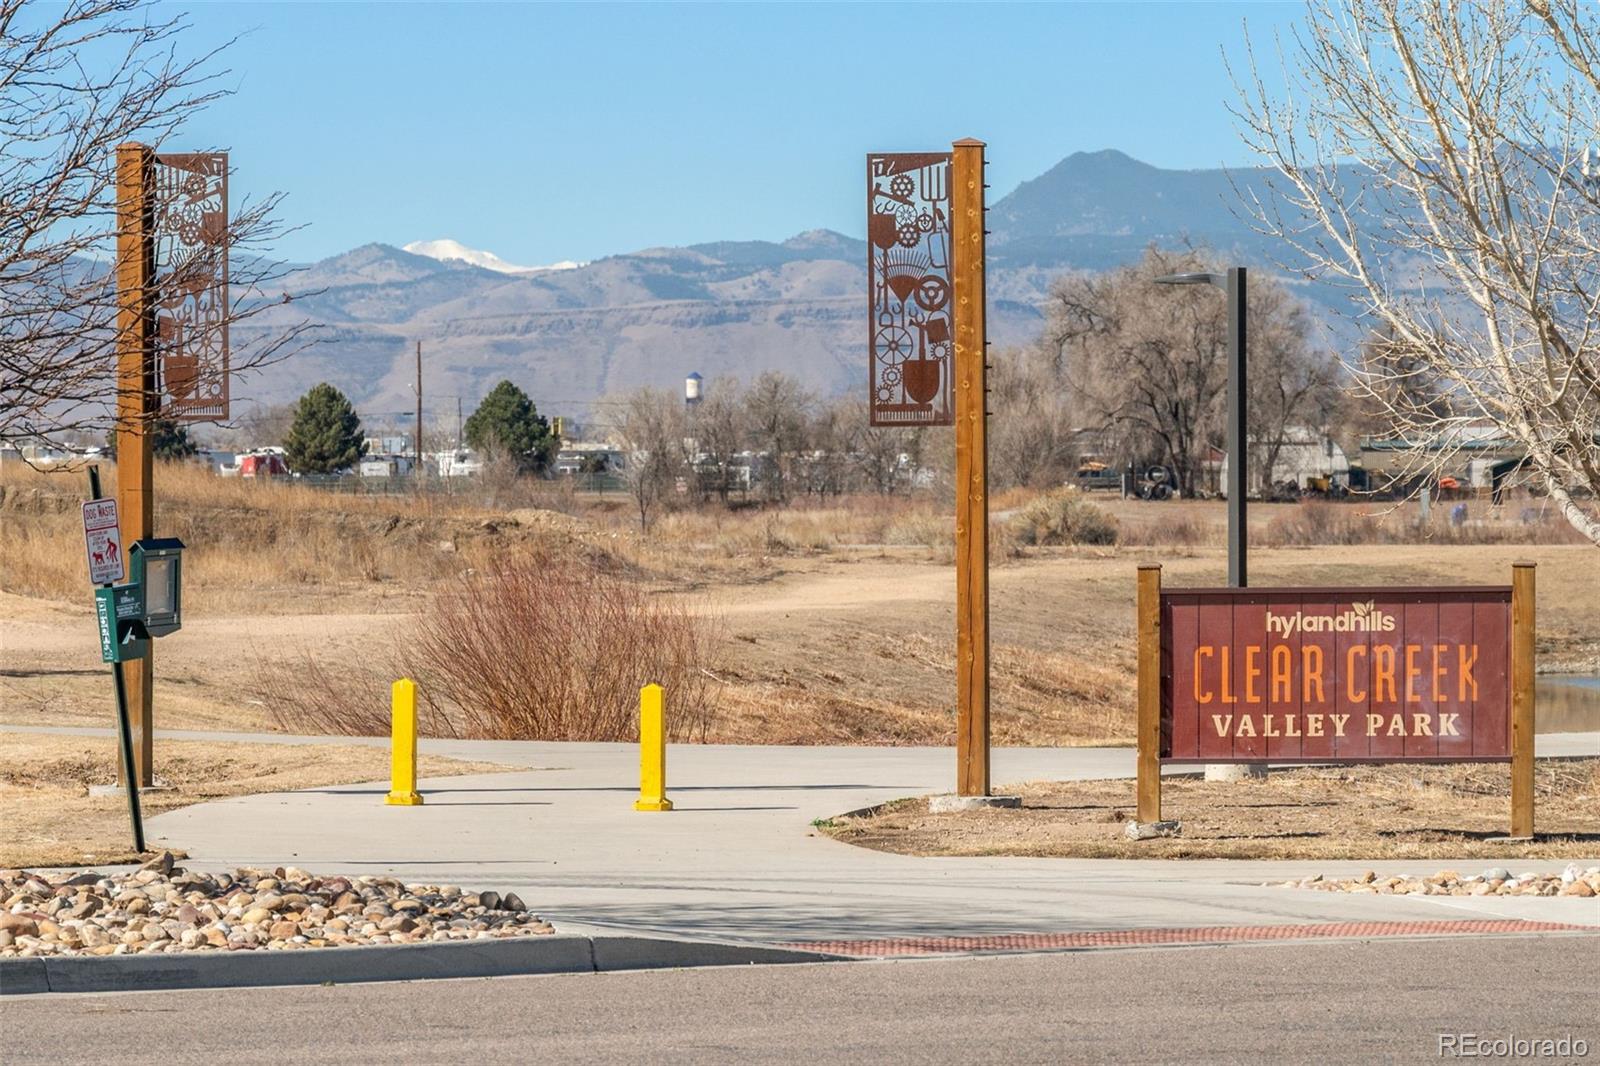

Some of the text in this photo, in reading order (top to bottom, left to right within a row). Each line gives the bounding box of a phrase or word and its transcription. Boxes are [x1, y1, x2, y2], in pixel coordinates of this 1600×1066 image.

[85, 505, 115, 520] DOG WASTE
[1265, 610, 1396, 639] hylandhills
[1193, 644, 1479, 704] CLEAR CREEK
[1212, 712, 1461, 738] VALLEY PARK
